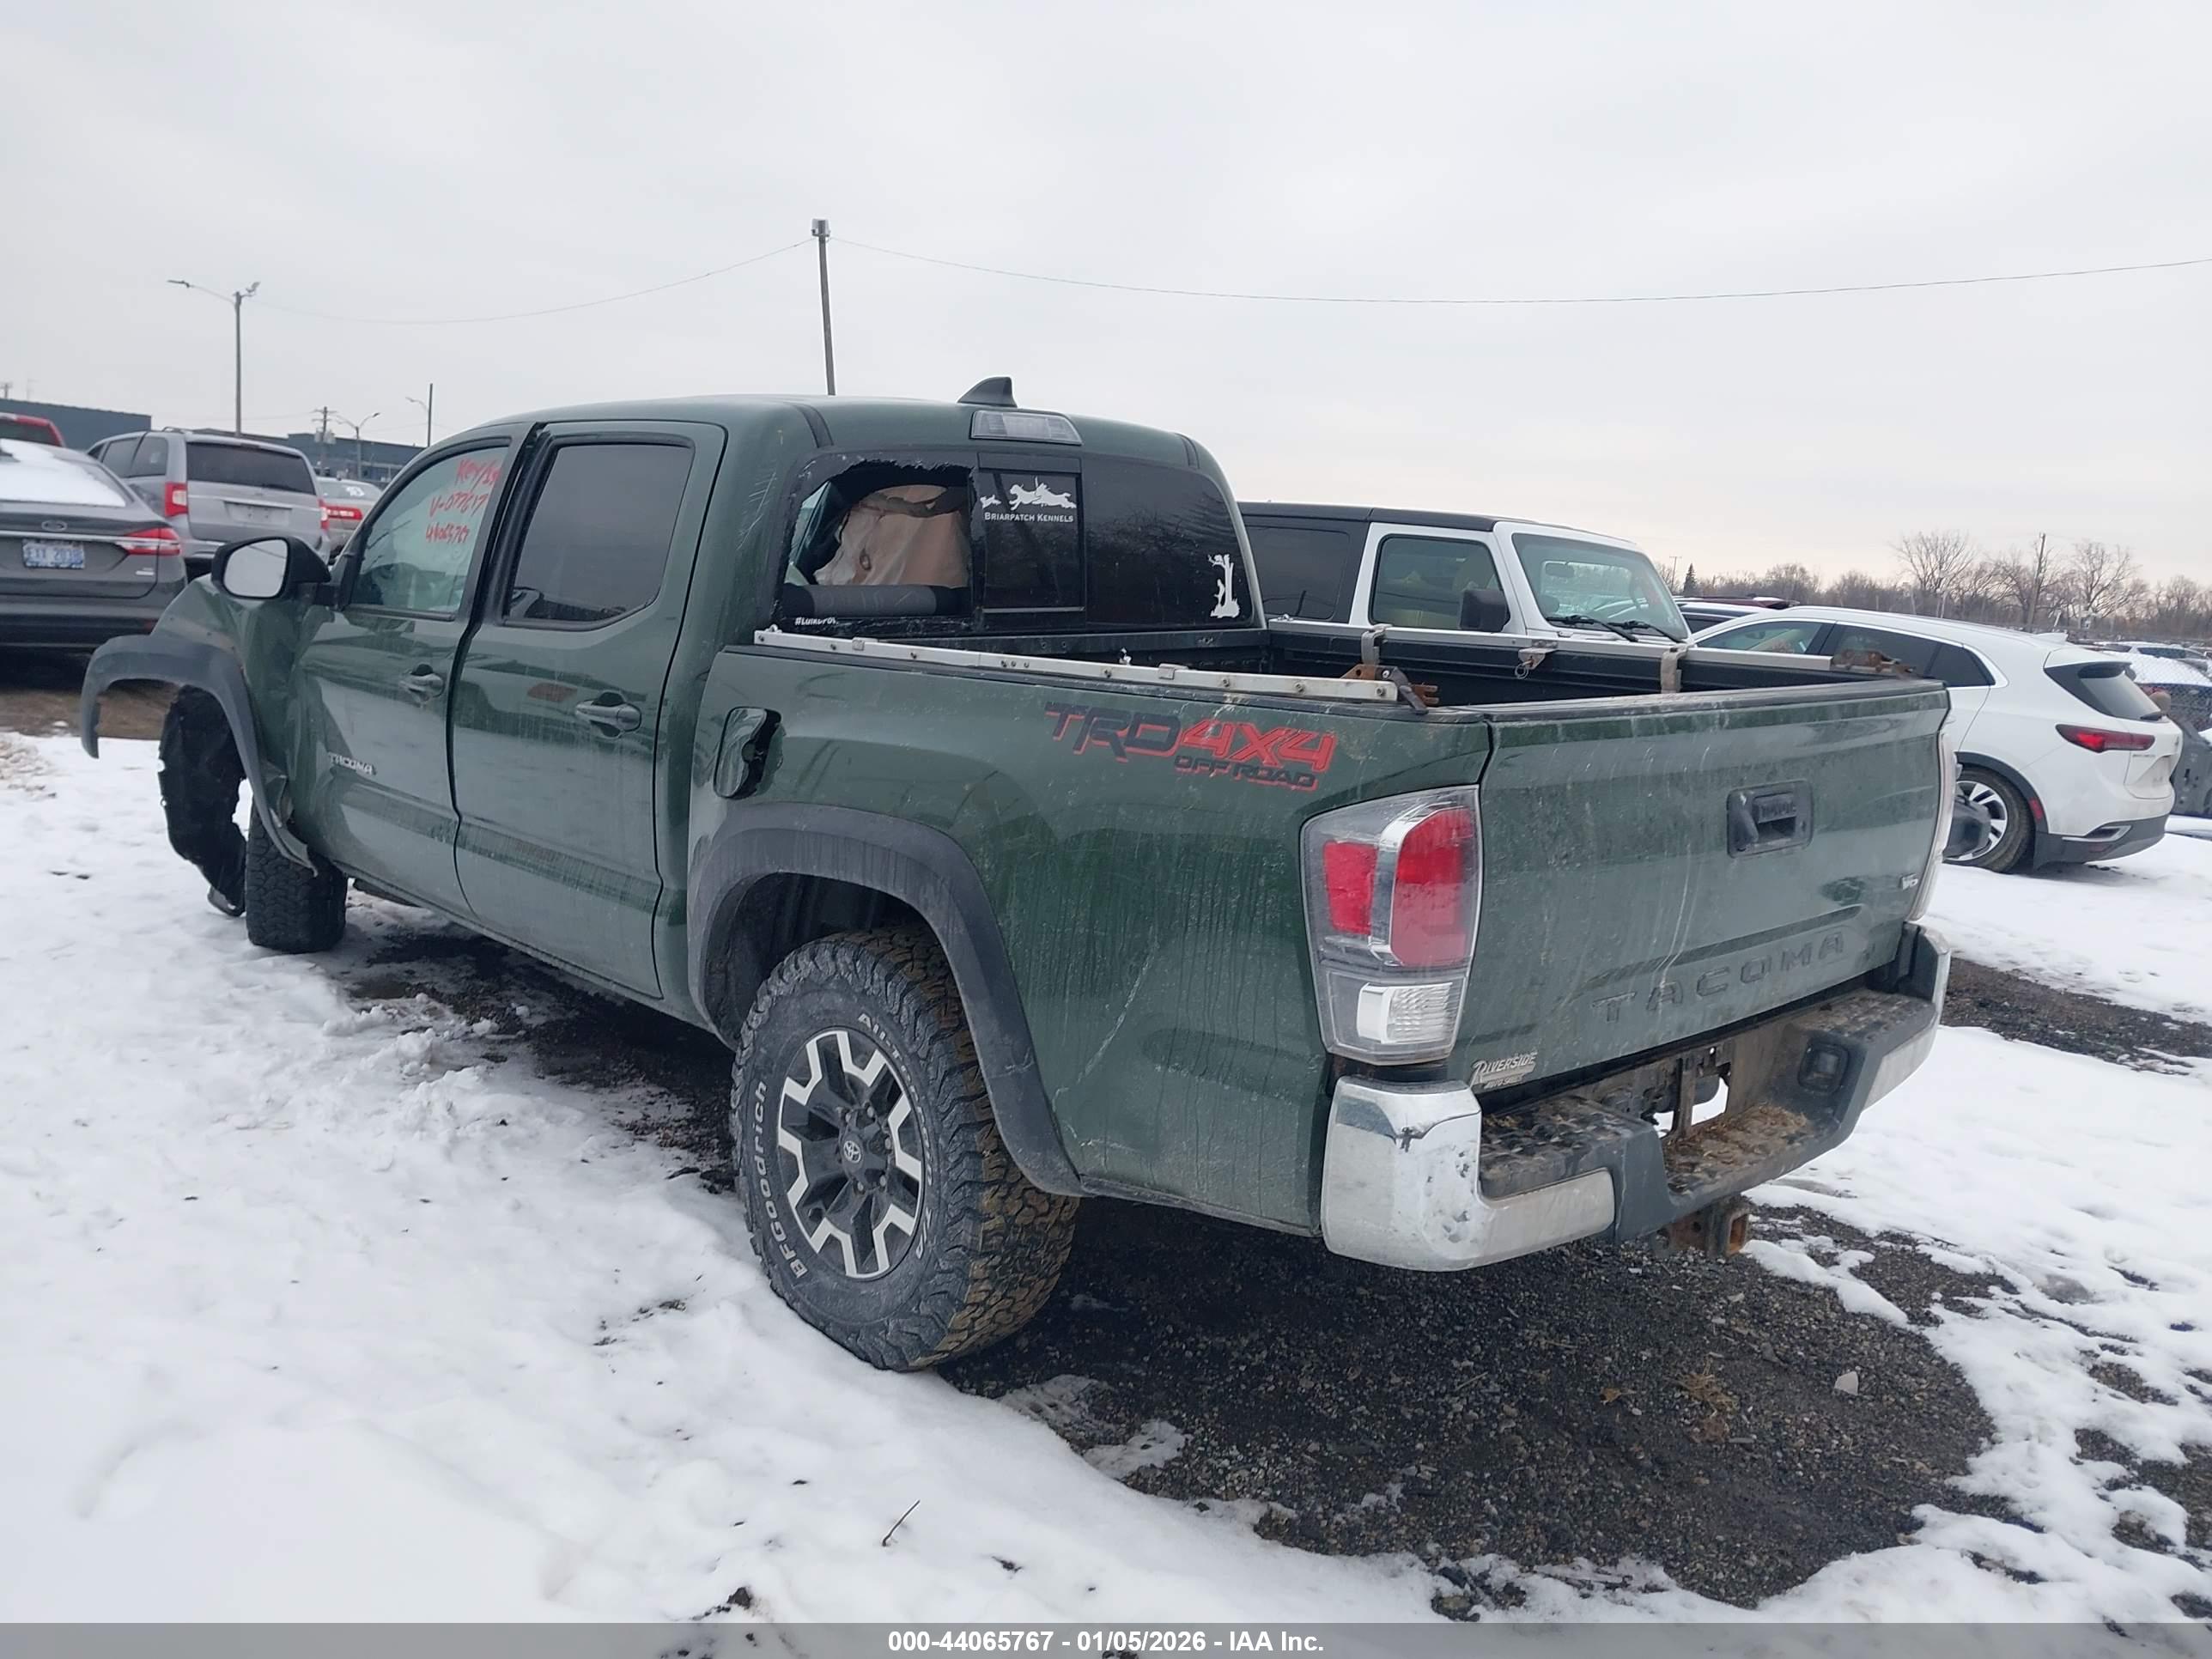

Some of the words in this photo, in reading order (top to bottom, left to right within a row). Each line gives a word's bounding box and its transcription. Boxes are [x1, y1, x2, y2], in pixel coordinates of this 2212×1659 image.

[1044, 702, 1182, 763] TRD
[327, 750, 375, 775] TACOMA
[1173, 755, 1231, 778] OFF
[1231, 762, 1318, 792] ROAD
[1590, 930, 1844, 1024] TACOMA
